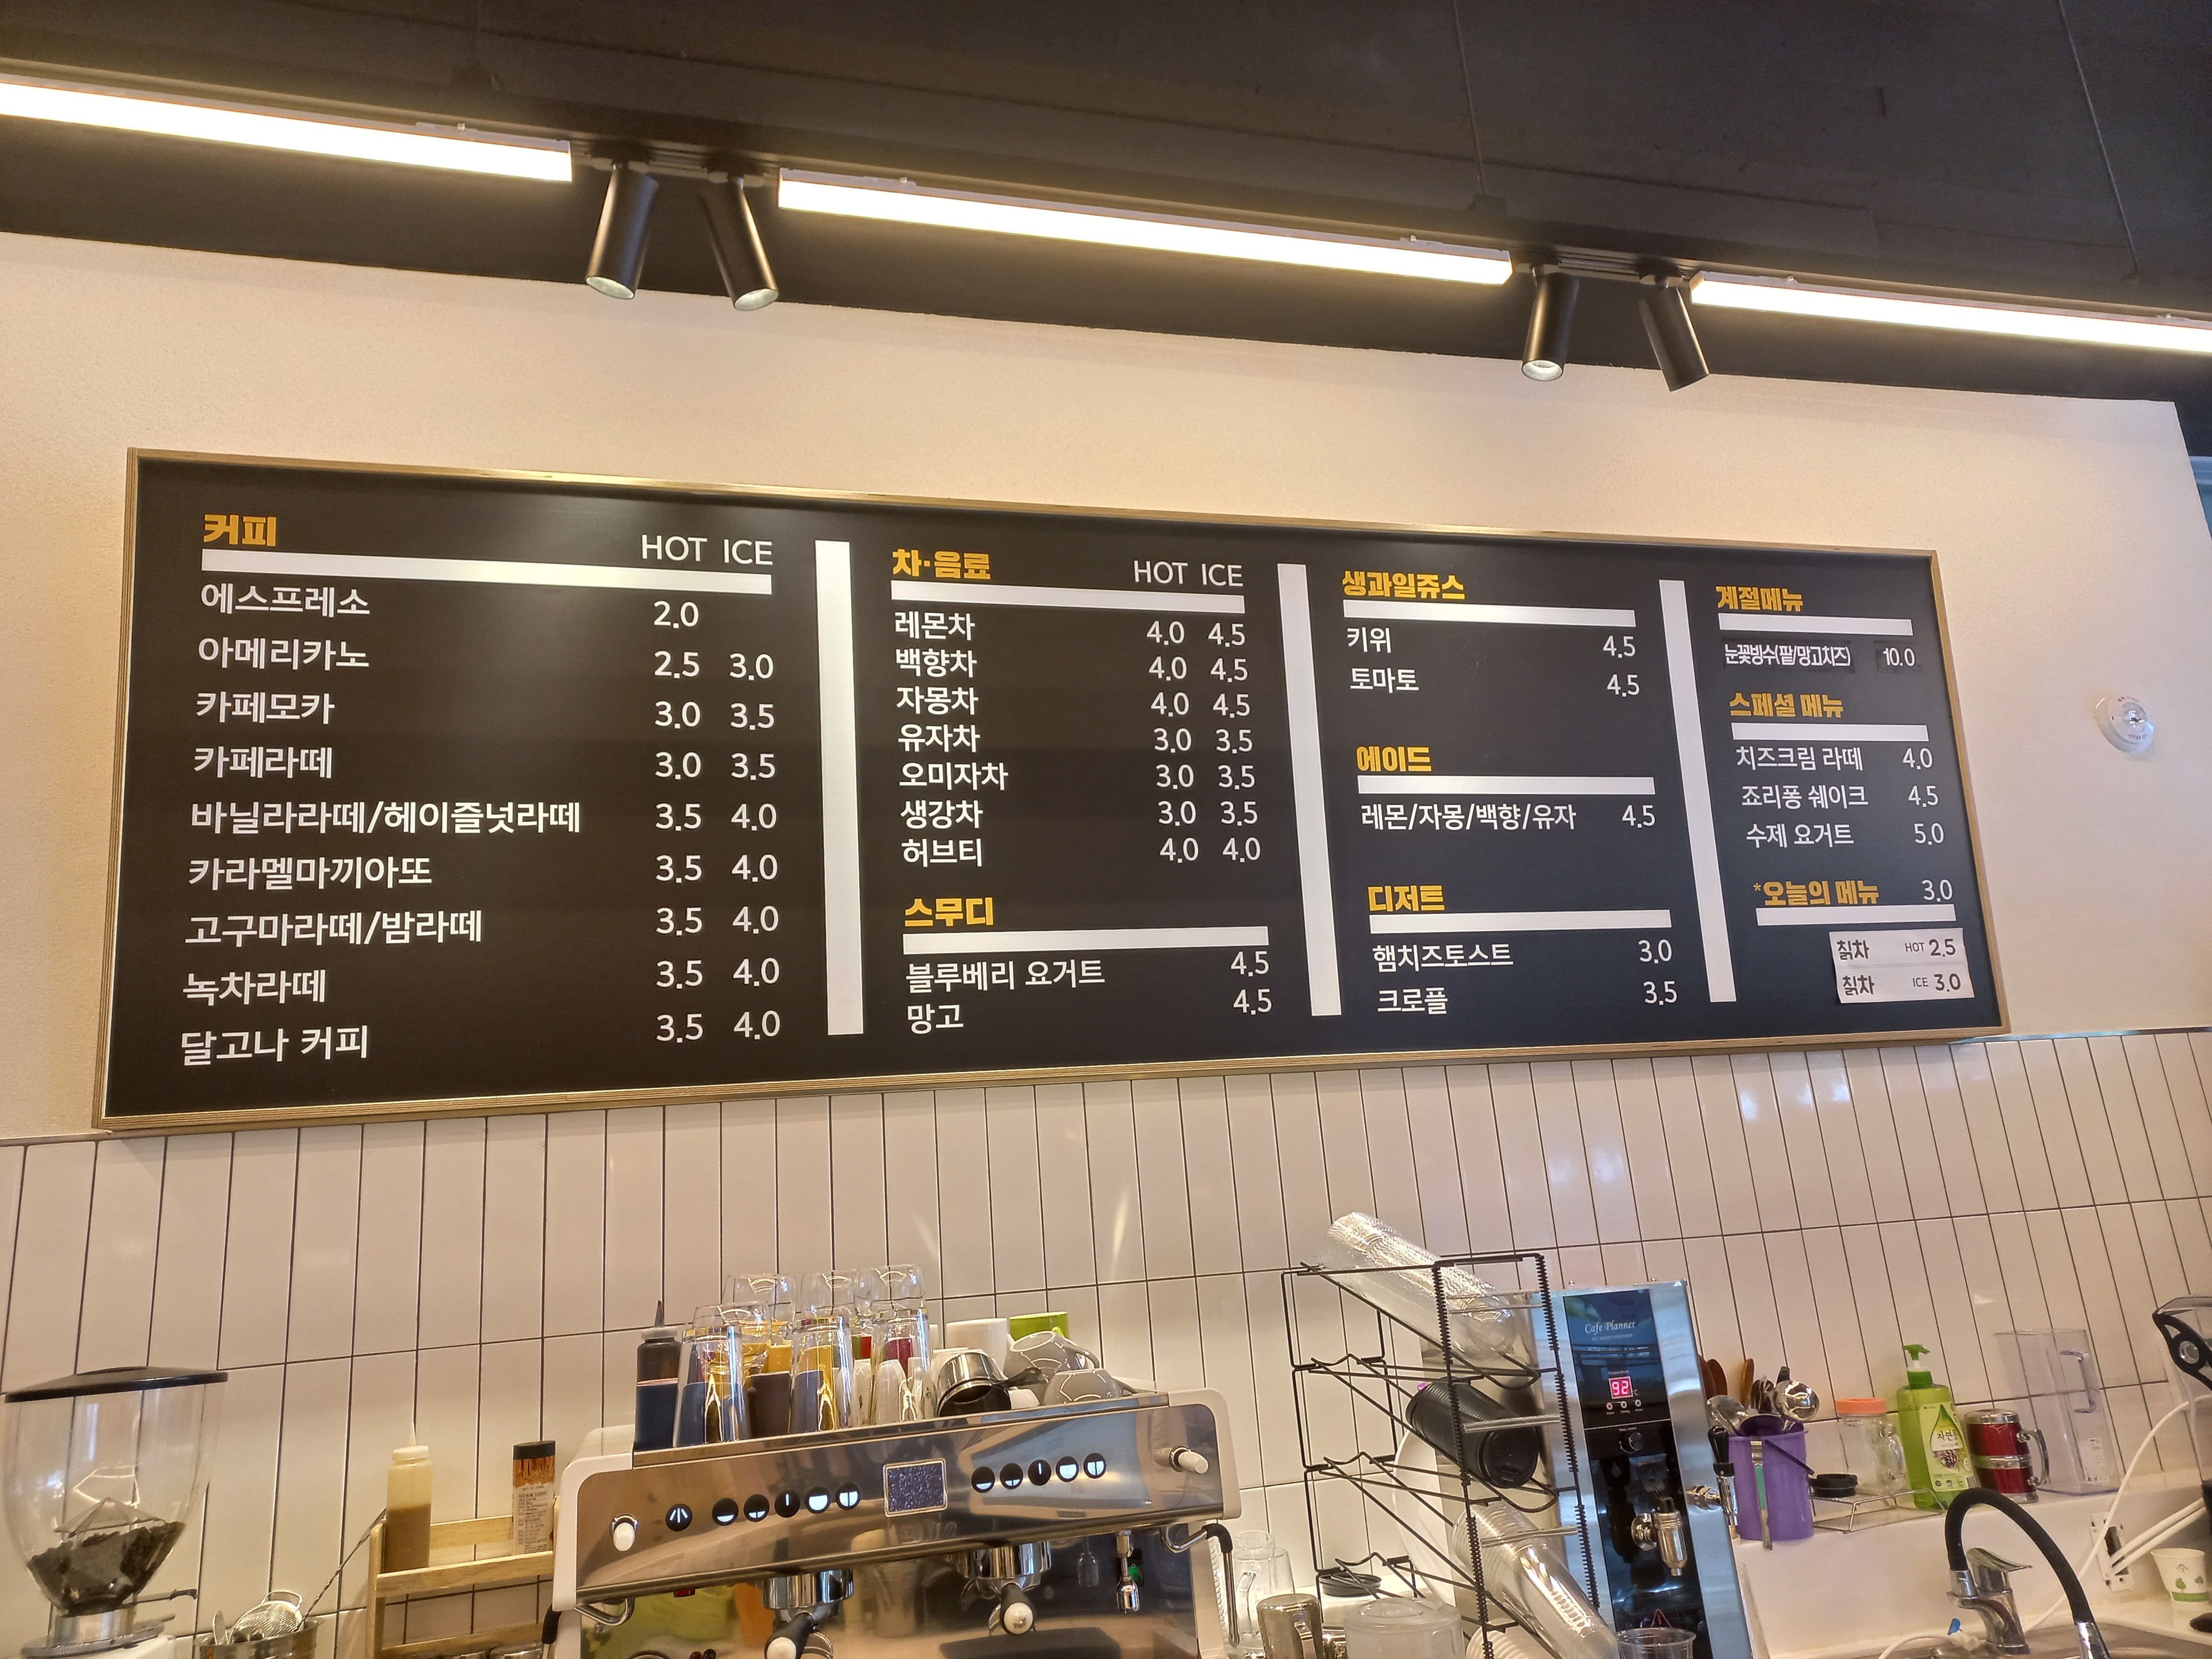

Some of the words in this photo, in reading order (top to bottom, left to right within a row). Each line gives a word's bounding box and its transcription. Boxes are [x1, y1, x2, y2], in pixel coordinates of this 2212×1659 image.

[203, 514, 276, 547] 커피
[642, 534, 708, 562] HOT
[724, 539, 773, 565] ICE
[1134, 560, 1188, 584] HOT
[1202, 564, 1243, 587] ICE
[1342, 571, 1465, 600] 생과일쥬스
[201, 583, 370, 618] 에스프레소
[654, 600, 699, 629] 2.0
[1715, 586, 1803, 612] 계절메뉴
[895, 611, 975, 641] 레몬차
[1146, 620, 1184, 645] 4.0
[1208, 622, 1245, 647] 4.5
[1347, 627, 1391, 653] 키위
[1603, 635, 1636, 658] 4.5
[199, 637, 369, 671] 아메리카노
[654, 651, 699, 679] 2.5
[730, 653, 774, 681] 3.0
[896, 648, 977, 678] 백향차
[1149, 656, 1187, 681] 4.0
[1210, 658, 1248, 683] 4.5
[1883, 647, 1915, 666] 10.0
[1350, 668, 1419, 694] 토마토
[1607, 674, 1640, 697] 4.5
[196, 691, 335, 724] 카페모카
[655, 701, 700, 729] 3.0
[730, 703, 774, 730] 3.5
[896, 686, 979, 715] 자몽차
[1150, 692, 1189, 717] 4.0
[1213, 693, 1250, 718] 4.5
[1729, 693, 1796, 717] 스페셜
[1800, 694, 1844, 718] 메뉴
[898, 724, 980, 752] 유자차
[1153, 728, 1192, 753] 3.0
[1216, 729, 1252, 754] 3.5
[194, 746, 332, 779] 카페라떼
[655, 752, 701, 780] 3.0
[731, 753, 775, 780] 3.5
[1357, 746, 1432, 772] 에이드
[1736, 746, 1816, 771] 치즈크림
[1822, 747, 1863, 771] 라떼
[1902, 748, 1933, 770] 4.0
[899, 762, 1008, 790] 오미자차
[1156, 764, 1194, 789] 3.0
[1218, 765, 1255, 790] 3.5
[1742, 785, 1802, 809] 죠리퐁
[1808, 785, 1869, 809] 쉐이크
[1908, 785, 1938, 807] 4.5
[191, 801, 579, 834] 바닐라라떼/헤이즐넛라떼
[655, 803, 701, 831] 3.5
[731, 803, 777, 831] 4.0
[900, 800, 984, 829] 생강차
[1158, 801, 1196, 826] 3.0
[1220, 801, 1258, 826] 3.5
[1361, 803, 1577, 830] 레몬/자몽/백향/유자
[1622, 805, 1655, 828] 4.5
[1746, 823, 1788, 848] 수제
[1794, 823, 1854, 848] 요거트
[1914, 823, 1944, 845] 5.0
[901, 838, 982, 867] 허브티
[1160, 838, 1199, 863] 4.0
[1222, 837, 1261, 863] 4.0
[188, 856, 432, 890] 카라멜마끼아또
[656, 855, 702, 883] 3.5
[731, 854, 778, 882] 4.0
[1368, 885, 1445, 912] 디저트
[1835, 880, 1879, 905] 메뉴
[1922, 879, 1953, 902] 3.0
[185, 910, 482, 947] 고구마라떼/밤라떼
[656, 907, 702, 936] 3.5
[732, 906, 779, 934] 4.0
[905, 897, 994, 927] 스무디
[1372, 944, 1514, 973] 햄치즈토스트
[1638, 939, 1672, 964] 3.0
[1836, 939, 1869, 960] 칡차
[1904, 942, 1924, 952] HOT
[1929, 938, 1956, 957] 2.5
[183, 969, 326, 1006] 녹차라떼
[656, 960, 703, 989] 3.5
[733, 957, 779, 986] 4.0
[906, 961, 1015, 994] 블루베리
[1025, 959, 1105, 988] 요거트
[1231, 951, 1269, 977] 4.5
[1842, 974, 1875, 996] 칡차
[1912, 977, 1929, 987] ICE
[1934, 973, 1961, 992] 3.0
[907, 1004, 964, 1034] 망고
[1233, 988, 1272, 1015] 4.5
[1378, 987, 1448, 1015] 크로플
[1643, 981, 1677, 1006] 3.5
[181, 1028, 289, 1066] 달고나
[301, 1025, 367, 1060] 커피
[656, 1013, 703, 1043] 3.5
[733, 1010, 780, 1040] 4.0
[1585, 1321, 1603, 1335] Cafe
[1604, 1320, 1636, 1331] Planner
[1612, 1381, 1628, 1395] 92
